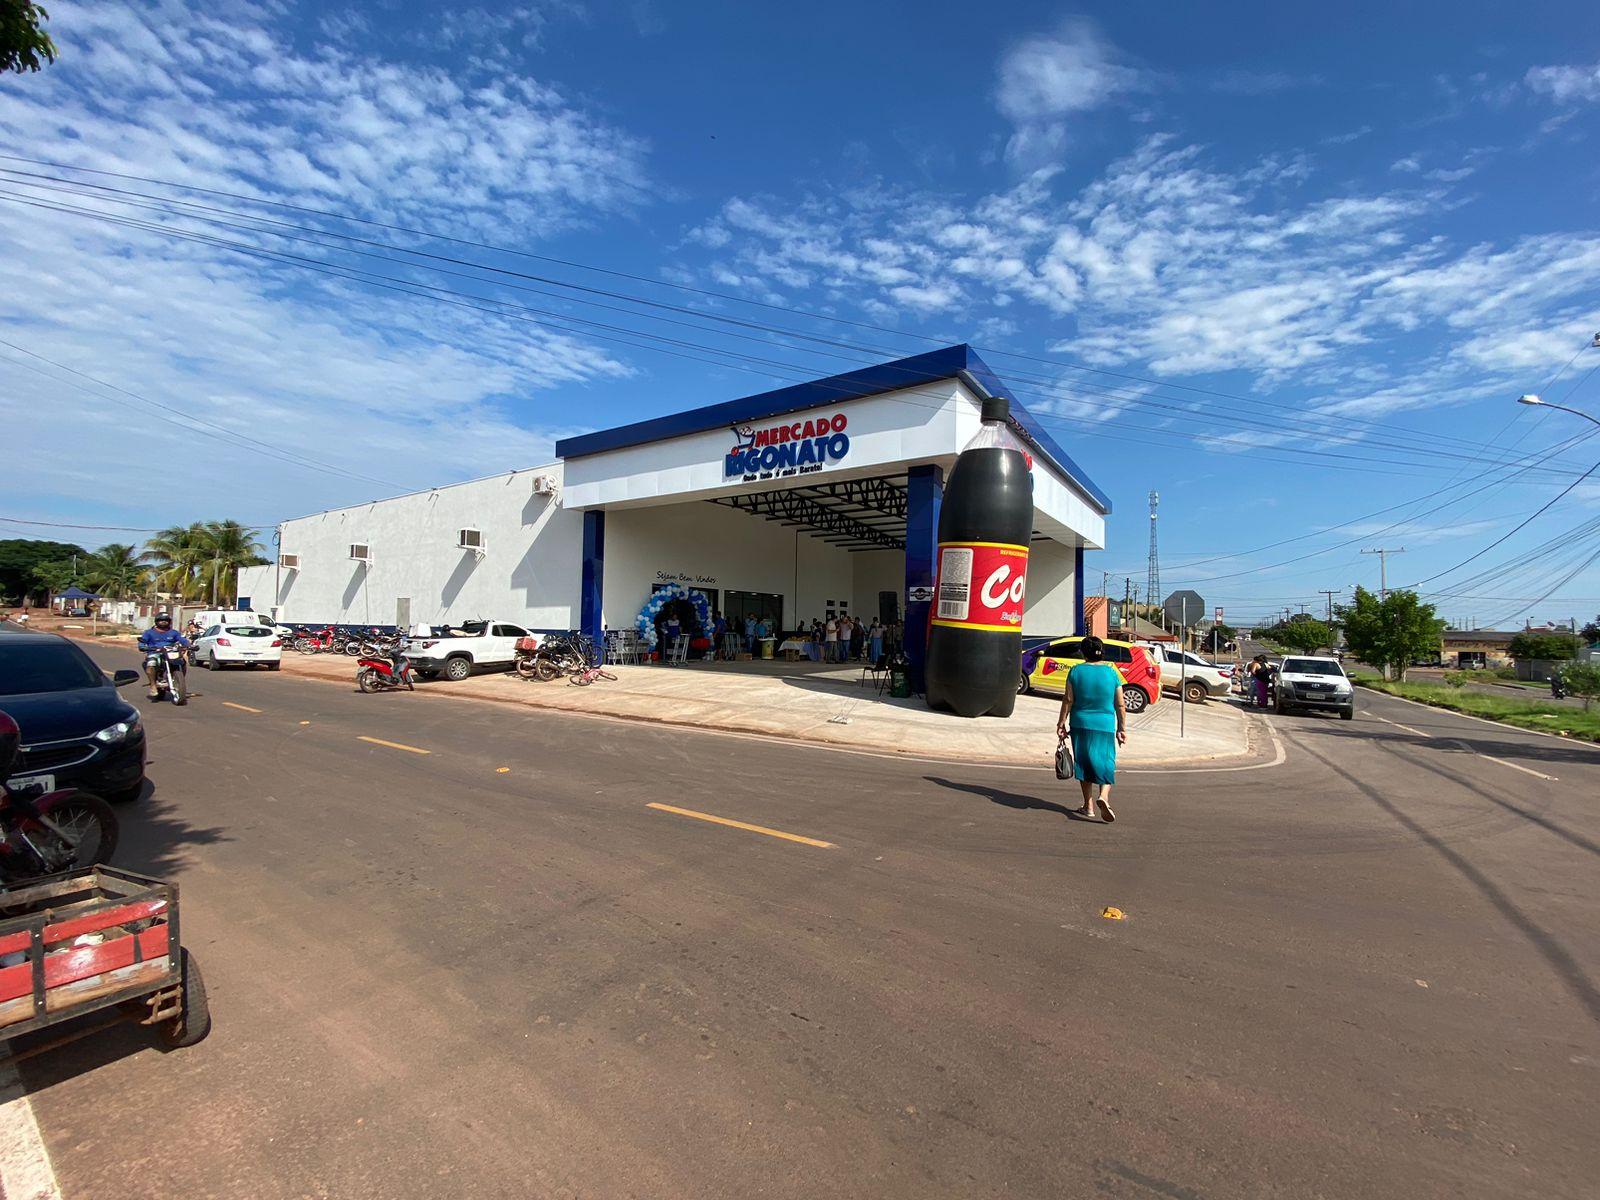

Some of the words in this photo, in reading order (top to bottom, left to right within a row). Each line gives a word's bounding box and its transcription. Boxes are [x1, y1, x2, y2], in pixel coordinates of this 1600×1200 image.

[755, 413, 848, 448] MERCADO
[725, 432, 850, 477] RIGONATO
[743, 473, 757, 482] Onde
[760, 471, 773, 479] tudo
[782, 467, 797, 476] mais
[656, 570, 678, 581] Sejam
